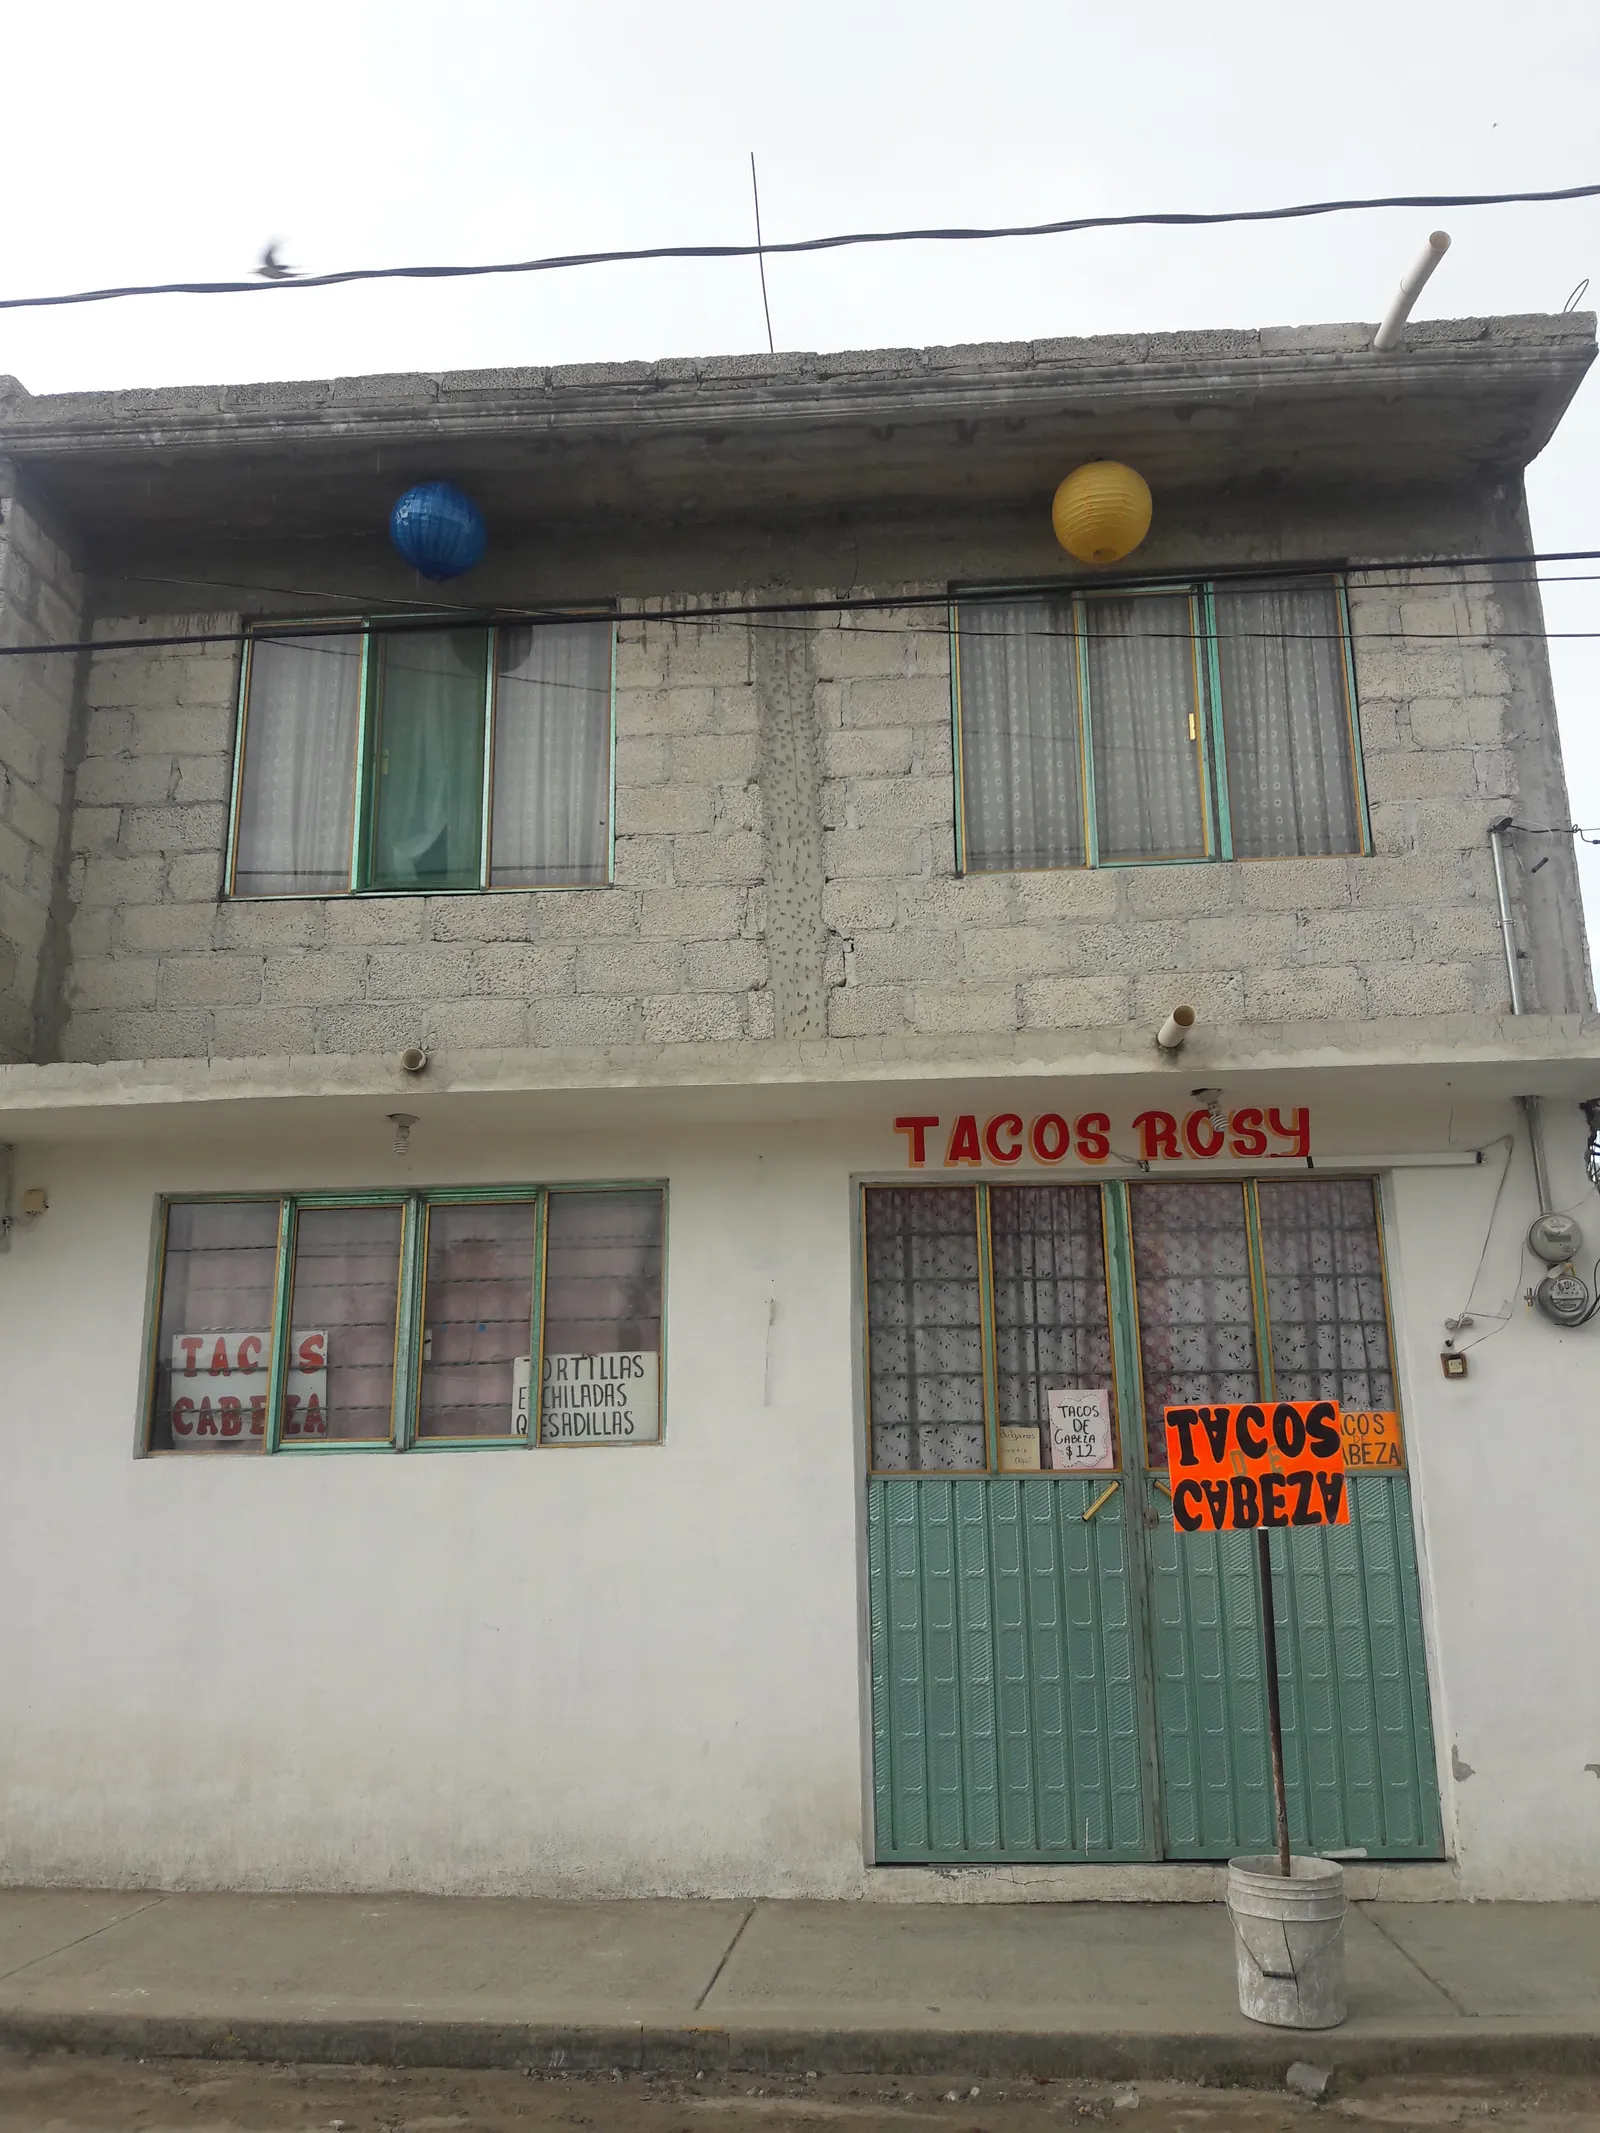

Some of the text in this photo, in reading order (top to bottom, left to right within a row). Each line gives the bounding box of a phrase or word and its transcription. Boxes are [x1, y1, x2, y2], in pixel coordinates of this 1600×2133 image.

[893, 1107, 1310, 1167] TACOS ROSY
[181, 1334, 325, 1377] TACS
[523, 1355, 645, 1381] ORTILLAS
[518, 1383, 628, 1410] ECHILADAS
[516, 1411, 635, 1437] QESADILLAS
[1057, 1405, 1100, 1419] TACOS
[1340, 1413, 1385, 1436] COS
[1054, 1428, 1096, 1445] CABEZA
[1072, 1419, 1091, 1434] DE
[1166, 1402, 1341, 1467] TACOS
[1230, 1445, 1284, 1477] DE
[1342, 1442, 1402, 1466] BEZA
[1173, 1470, 1345, 1532] CABEZA
